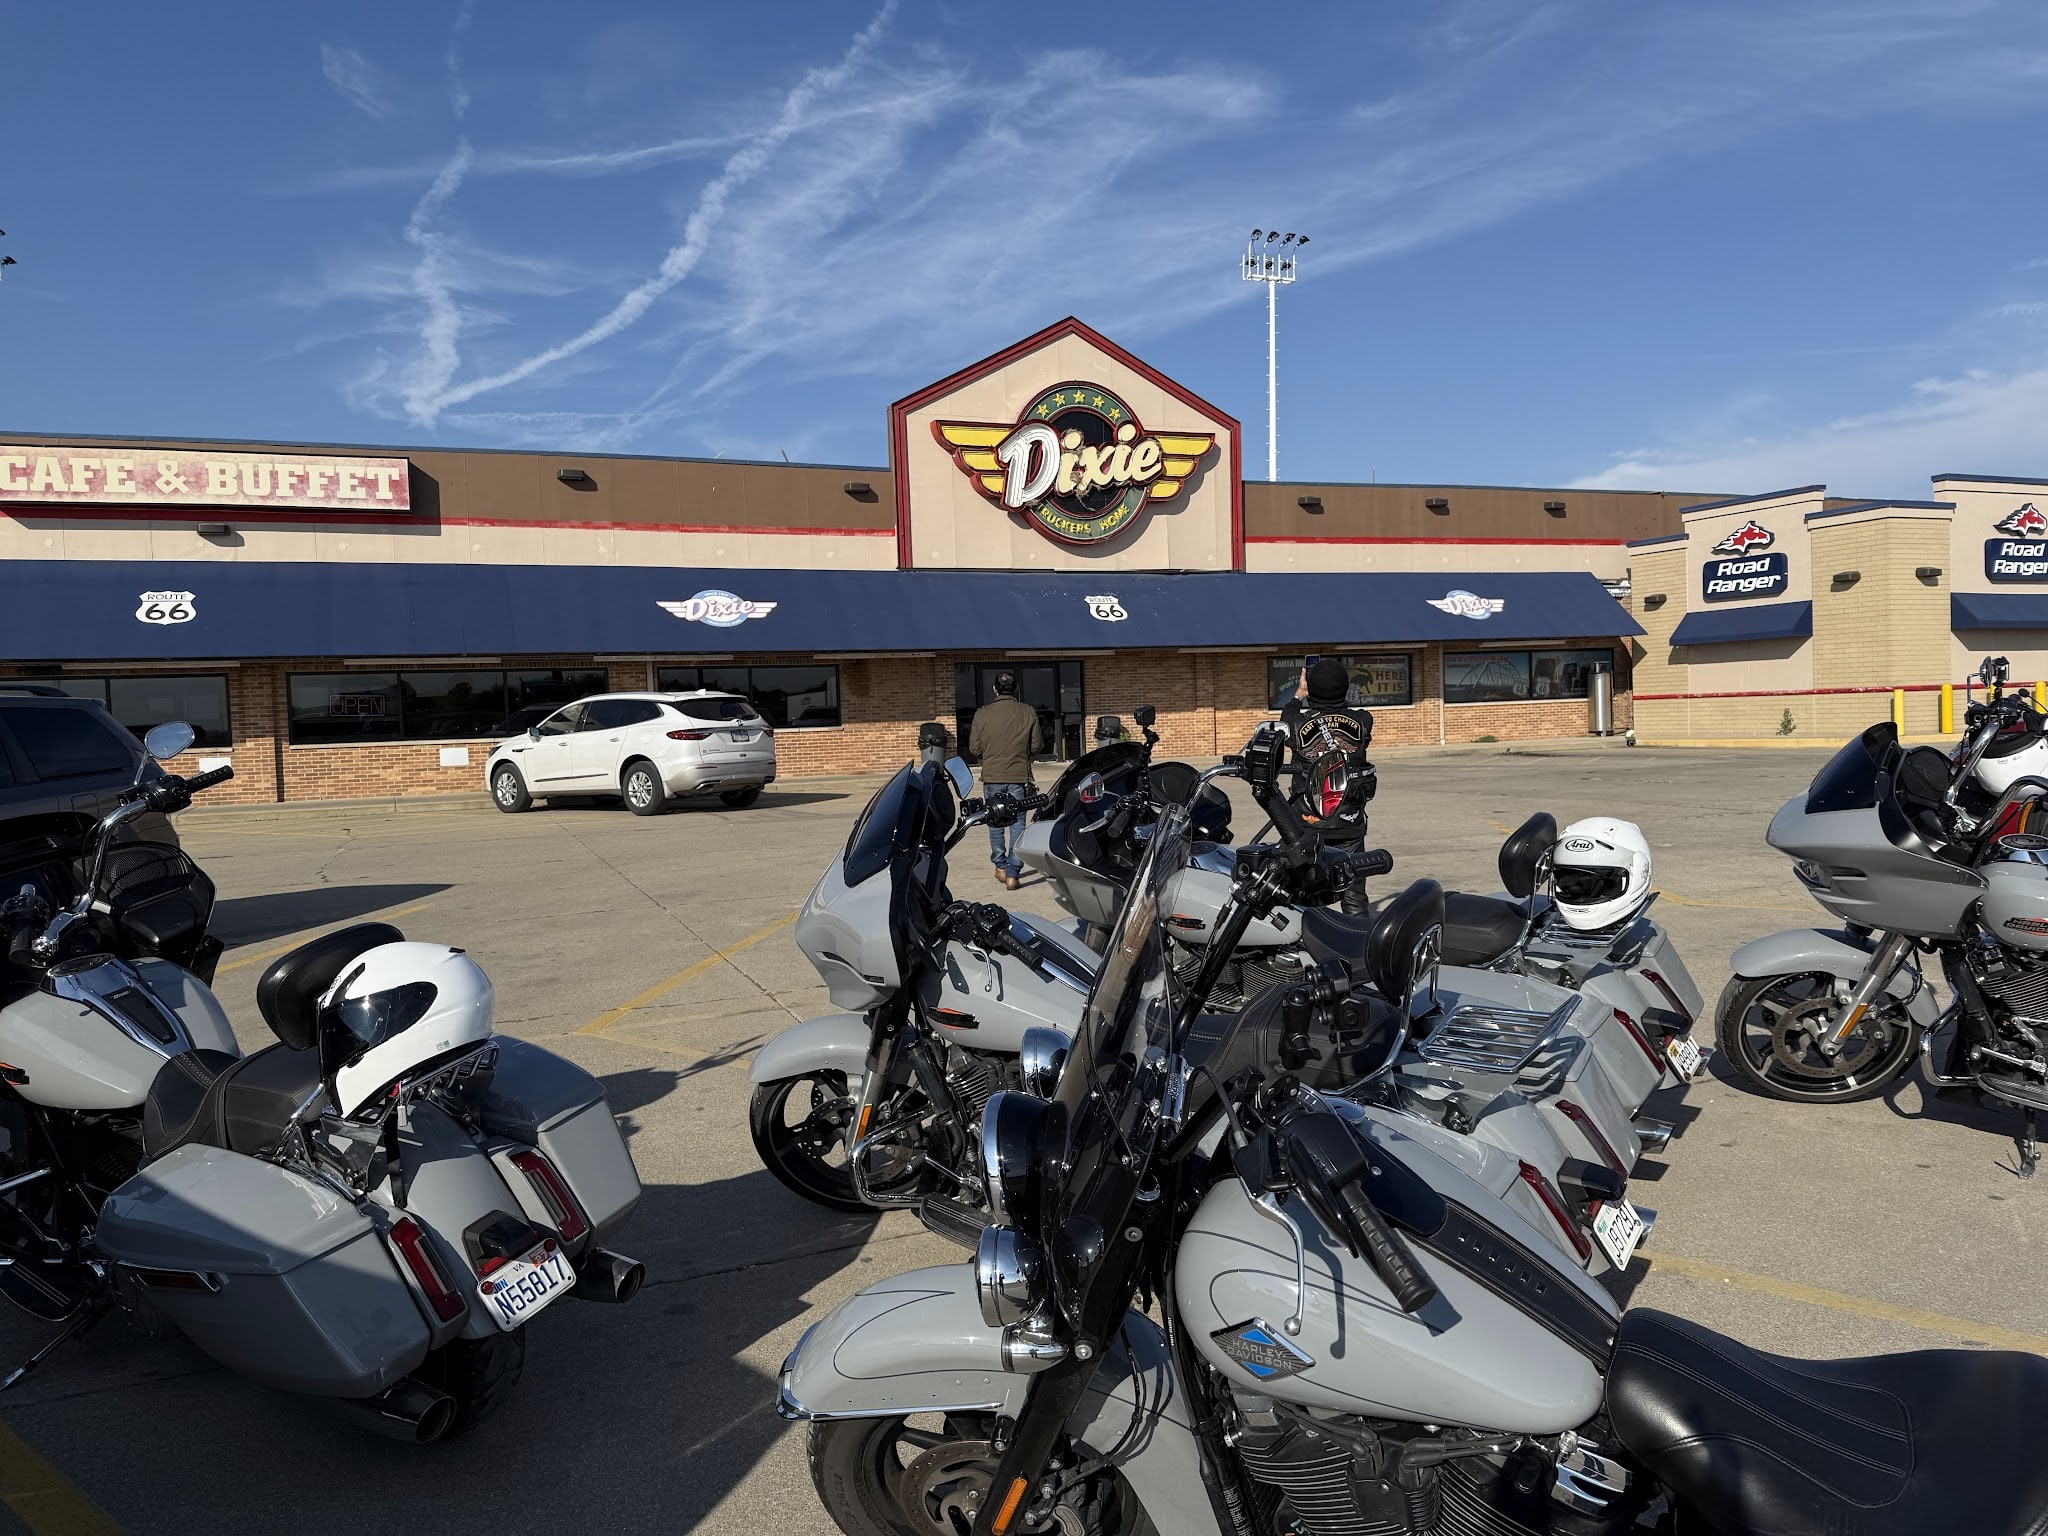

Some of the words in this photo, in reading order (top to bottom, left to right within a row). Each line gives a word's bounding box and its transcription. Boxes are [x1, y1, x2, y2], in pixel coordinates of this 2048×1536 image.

[998, 423, 1161, 508] Dixie
[0, 456, 136, 494] CAFE
[155, 459, 191, 494] &
[205, 461, 400, 500] BUFFET
[1099, 505, 1130, 531] HOME
[2001, 542, 2045, 557] Road
[1717, 557, 1770, 576] Road
[1707, 574, 1781, 594] Ranger
[145, 603, 189, 620] 66
[681, 597, 755, 621] Dixie
[1096, 605, 1124, 618] 66
[1443, 596, 1491, 615] Dixie
[1273, 660, 1294, 668] SANTA
[1376, 671, 1405, 680] HERE
[1377, 683, 1389, 692] IT
[1393, 682, 1403, 692] IS
[332, 697, 382, 714] OPEN
[1301, 723, 1315, 736] EAST
[1334, 716, 1358, 729] CHAPTER
[1571, 840, 1590, 849] Arai
[535, 1252, 548, 1262] 27
[513, 1263, 524, 1273] VA
[494, 1255, 565, 1320] N55817
[1226, 1346, 1291, 1370] DAVIDSON
